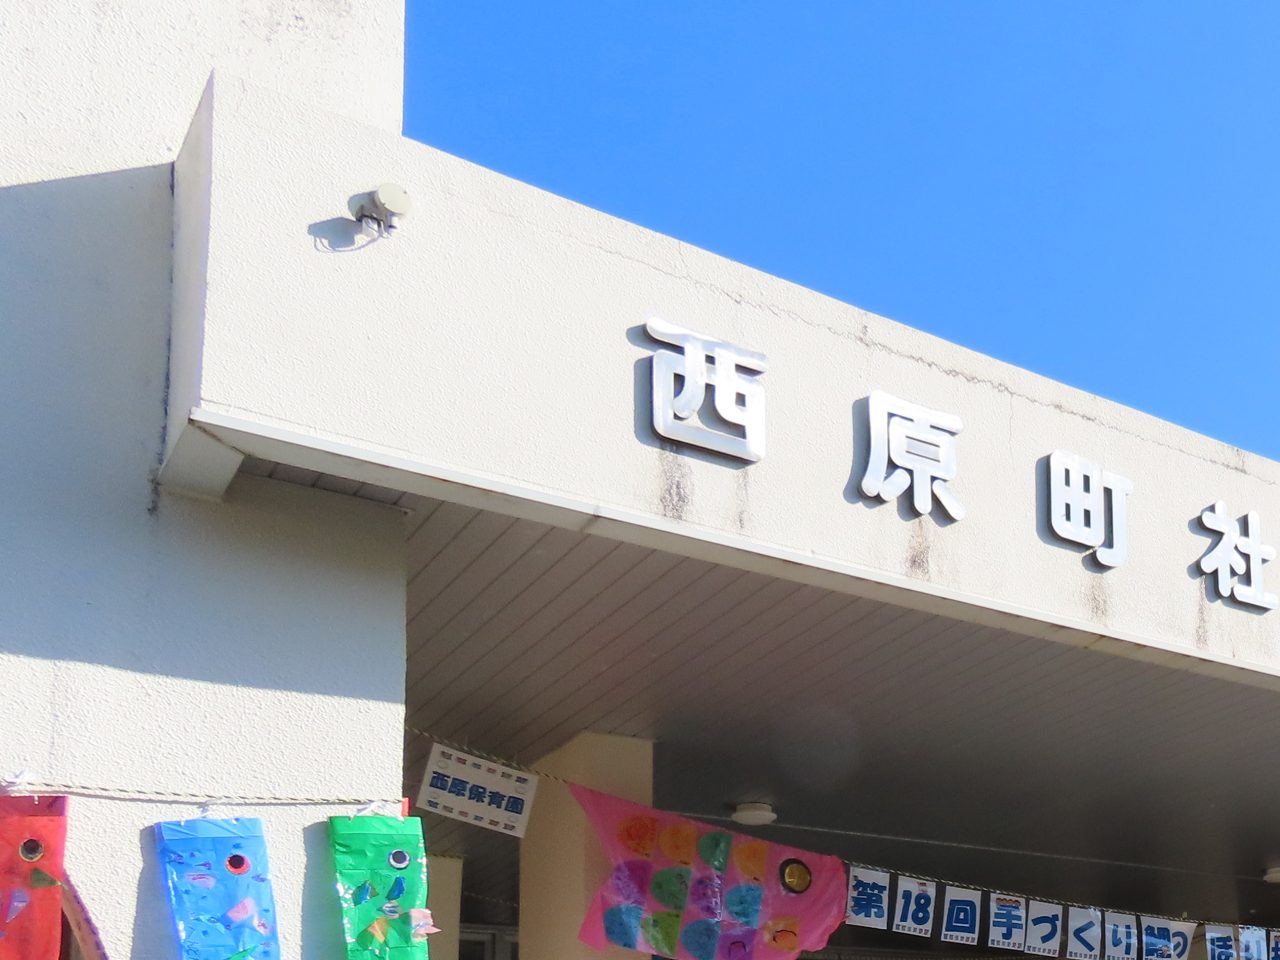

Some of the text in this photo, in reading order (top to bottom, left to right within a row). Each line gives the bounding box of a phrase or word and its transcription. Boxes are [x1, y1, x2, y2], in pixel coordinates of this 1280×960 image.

[429, 771, 525, 815] 西原保育園
